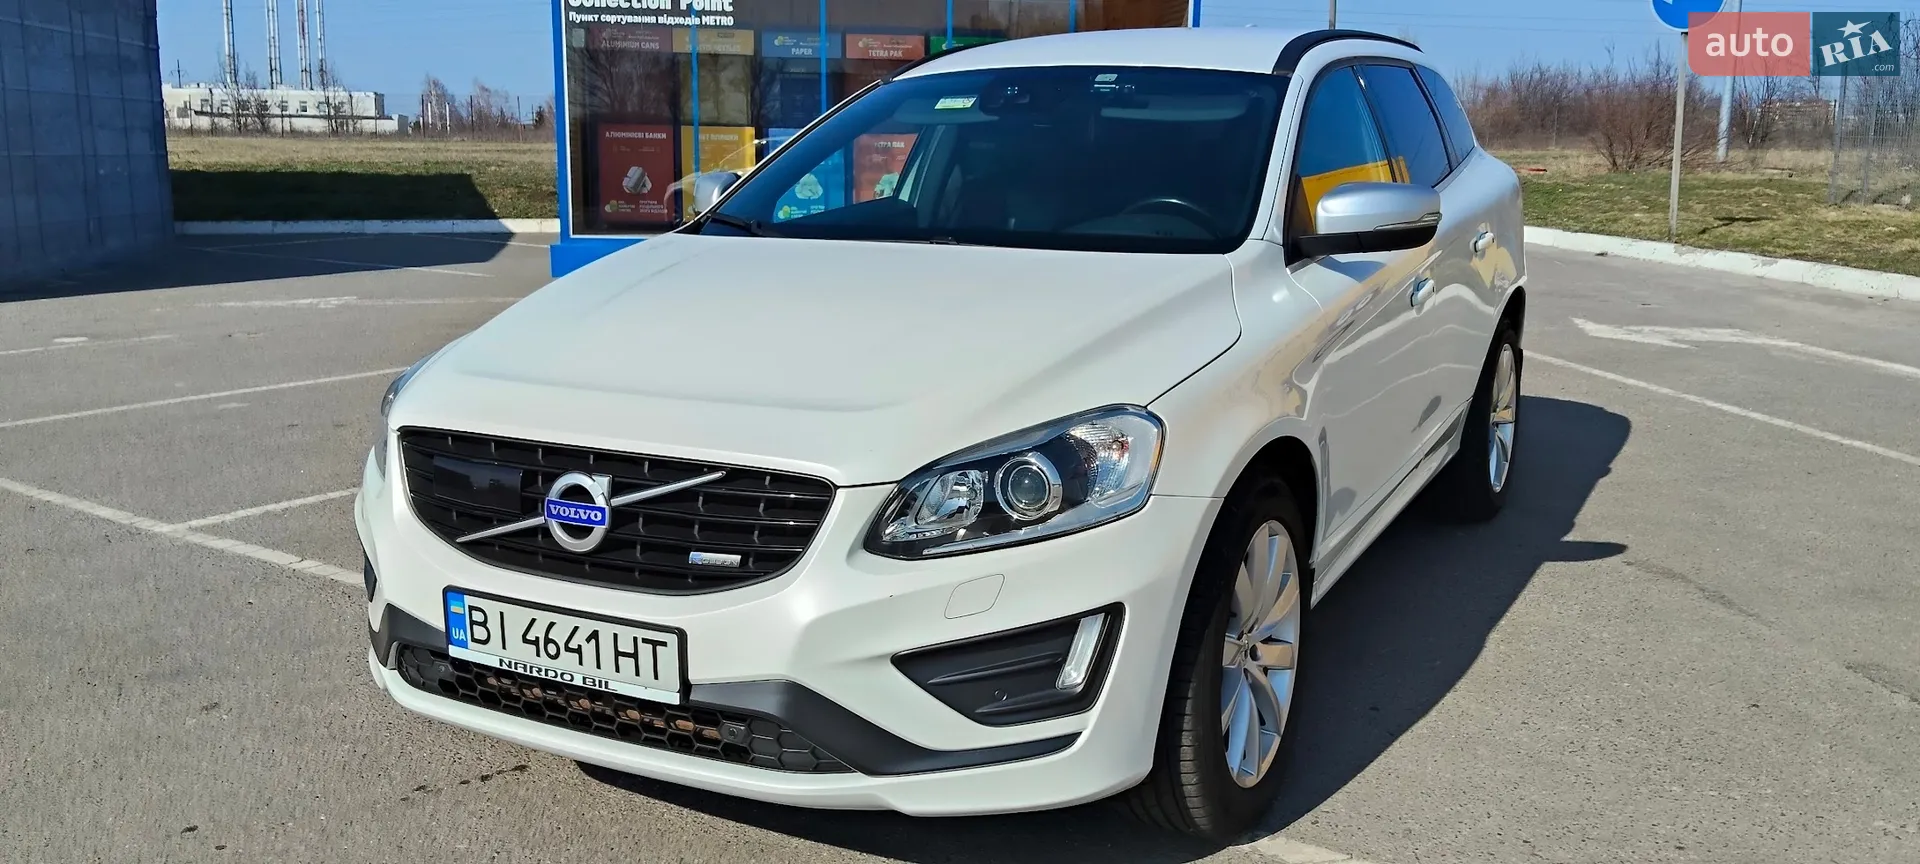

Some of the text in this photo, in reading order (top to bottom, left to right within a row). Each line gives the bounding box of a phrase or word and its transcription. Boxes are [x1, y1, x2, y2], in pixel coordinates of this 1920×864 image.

[568, 11, 735, 26] Пункт сортування відходів METRO
[601, 40, 660, 50] ALUMINIUM CANS
[791, 47, 813, 56] PAPER
[868, 49, 904, 58] TETRA PAK
[548, 504, 602, 523] VOLVO
[451, 627, 466, 641] UA
[467, 604, 668, 680] BI 4641 HT
[499, 657, 619, 692] NARDO BIL
